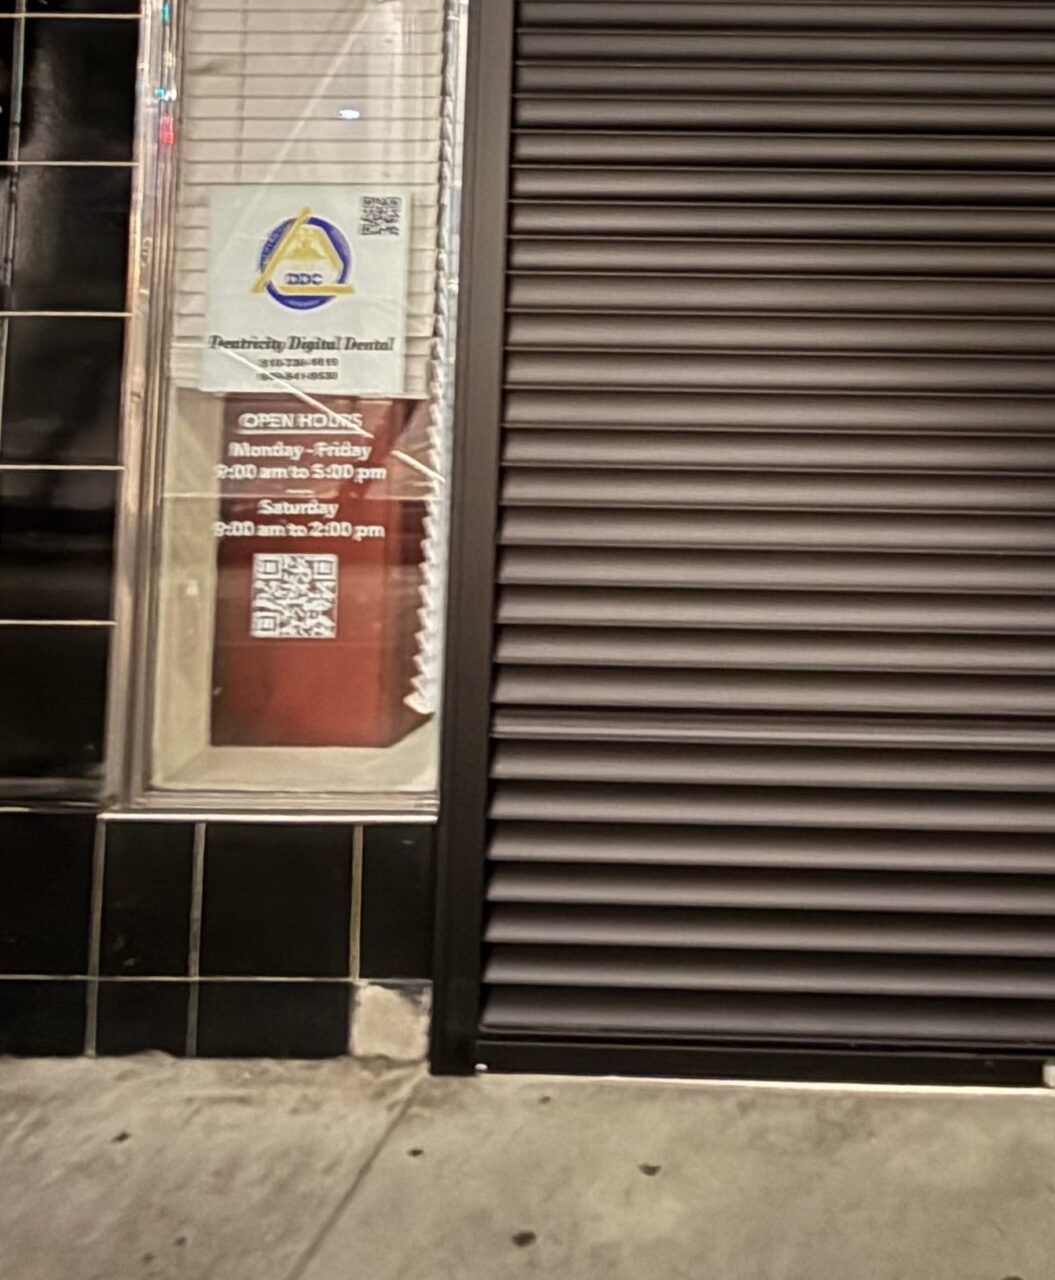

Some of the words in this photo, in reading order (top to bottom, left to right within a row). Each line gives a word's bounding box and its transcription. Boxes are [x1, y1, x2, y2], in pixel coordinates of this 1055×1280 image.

[284, 272, 324, 286] DDC
[288, 335, 341, 353] Digital
[344, 336, 395, 351] Dental
[238, 413, 295, 429] OPEN
[228, 441, 304, 461] Monday
[314, 441, 373, 461] Friday
[259, 467, 289, 480] am
[290, 466, 310, 480] to
[311, 464, 354, 480] 5:00
[354, 467, 388, 484] pm
[257, 498, 340, 519] Saturday
[213, 521, 255, 537] 9:00
[256, 524, 286, 537] am
[287, 523, 307, 537] to
[308, 521, 352, 537] 2:00
[352, 524, 386, 542] pm
